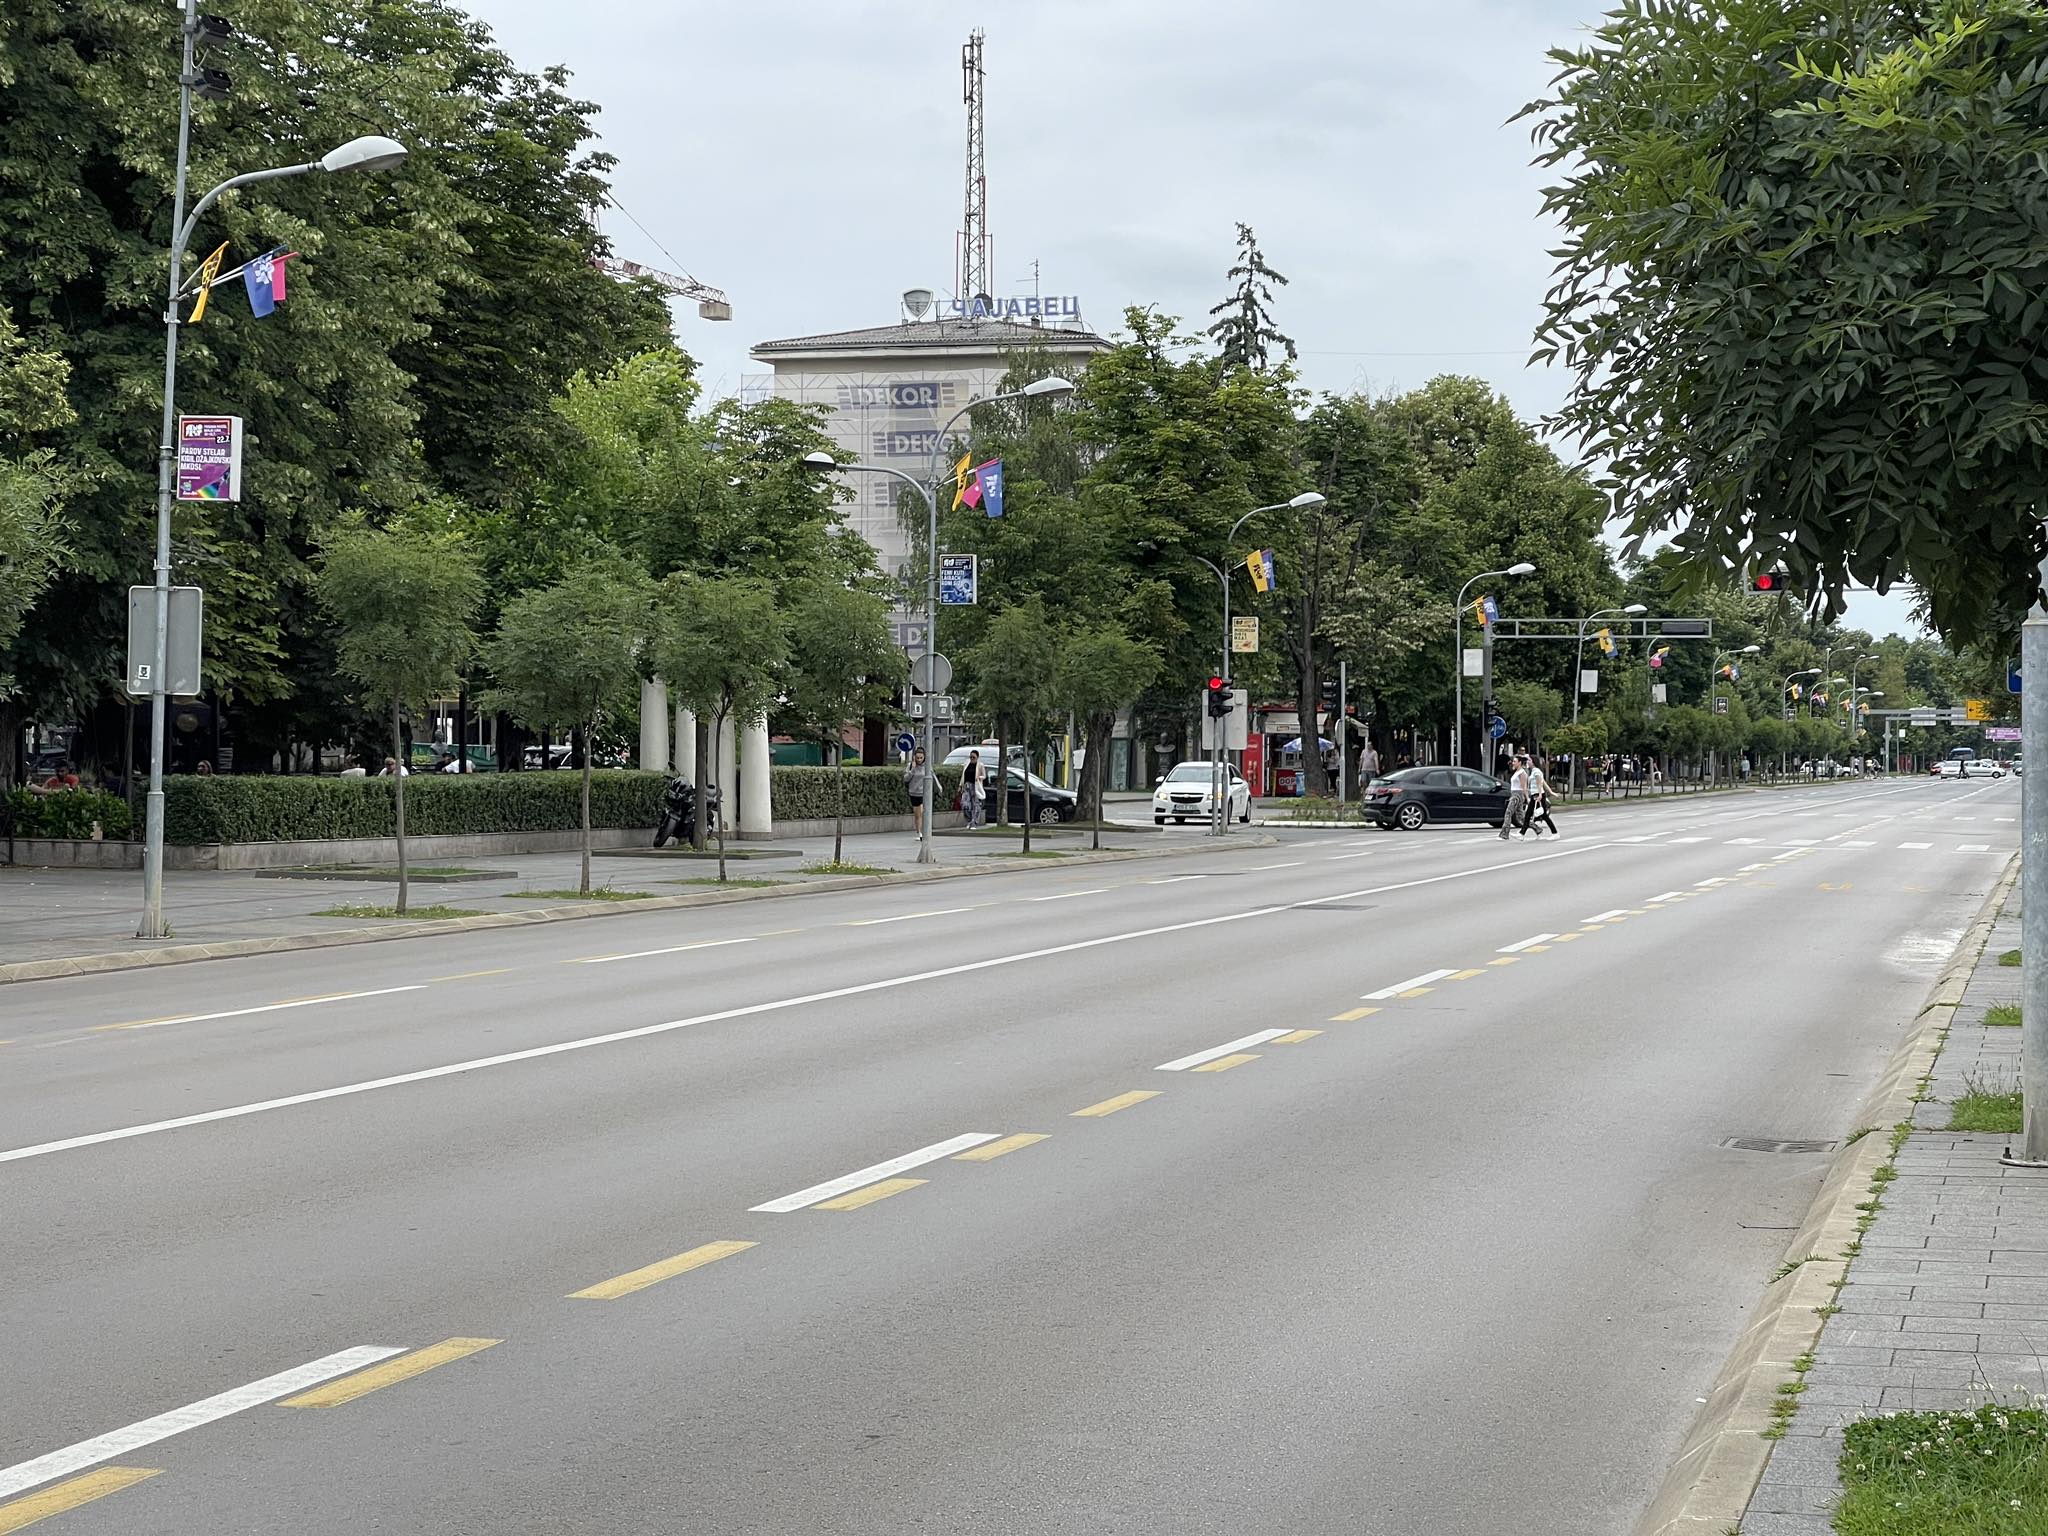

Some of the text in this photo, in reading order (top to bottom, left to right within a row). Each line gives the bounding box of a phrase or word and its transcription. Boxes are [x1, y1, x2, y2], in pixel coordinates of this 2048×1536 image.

[952, 296, 1079, 317] ЧАЈАВЕЦ
[859, 386, 933, 405] DEKOR
[181, 447, 226, 456] PAROV STELAR
